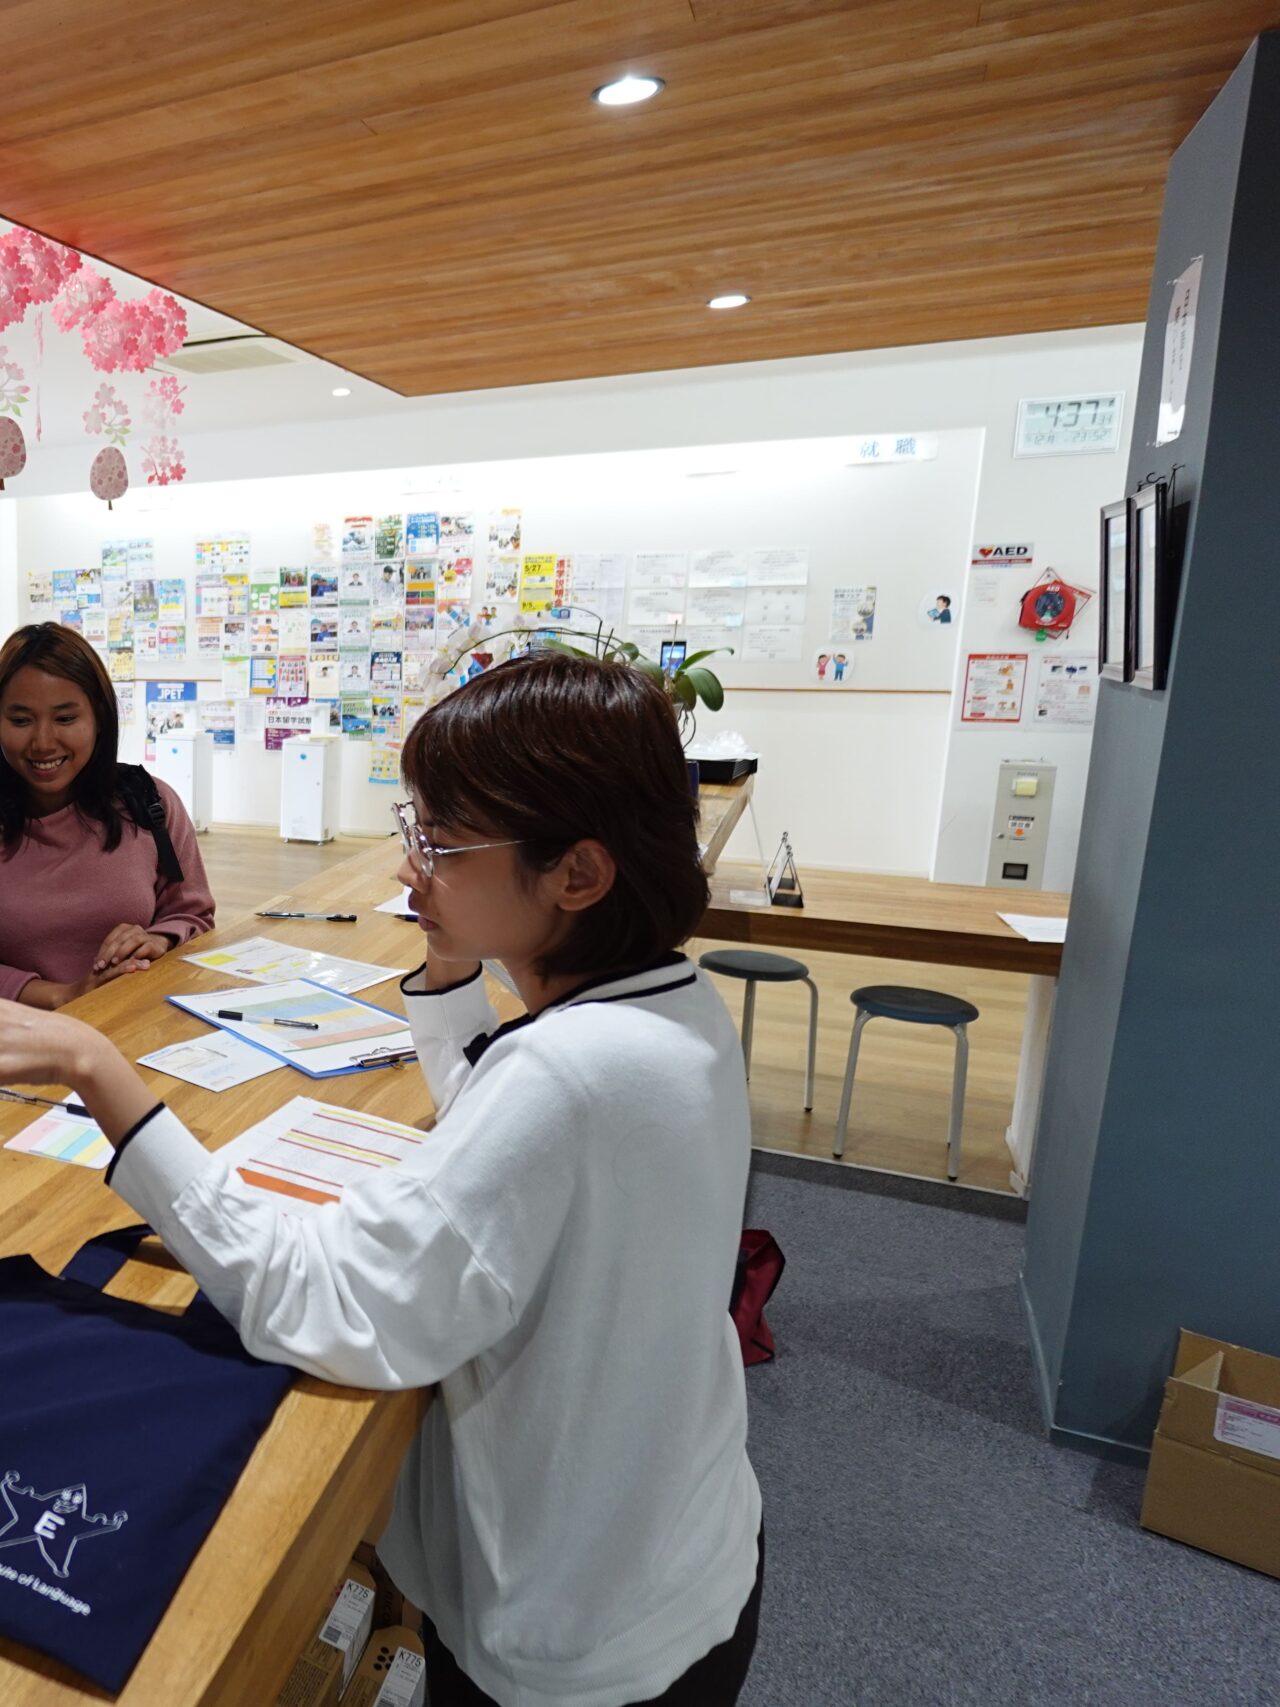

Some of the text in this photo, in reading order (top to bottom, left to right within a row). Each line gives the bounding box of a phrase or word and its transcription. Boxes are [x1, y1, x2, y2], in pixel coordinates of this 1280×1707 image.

[992, 545, 1029, 556] AED
[157, 688, 185, 700] JPET
[33, 1510, 66, 1540] E
[17, 1574, 35, 1587] of
[31, 1577, 91, 1617] Language
[398, 1650, 423, 1668] K775
